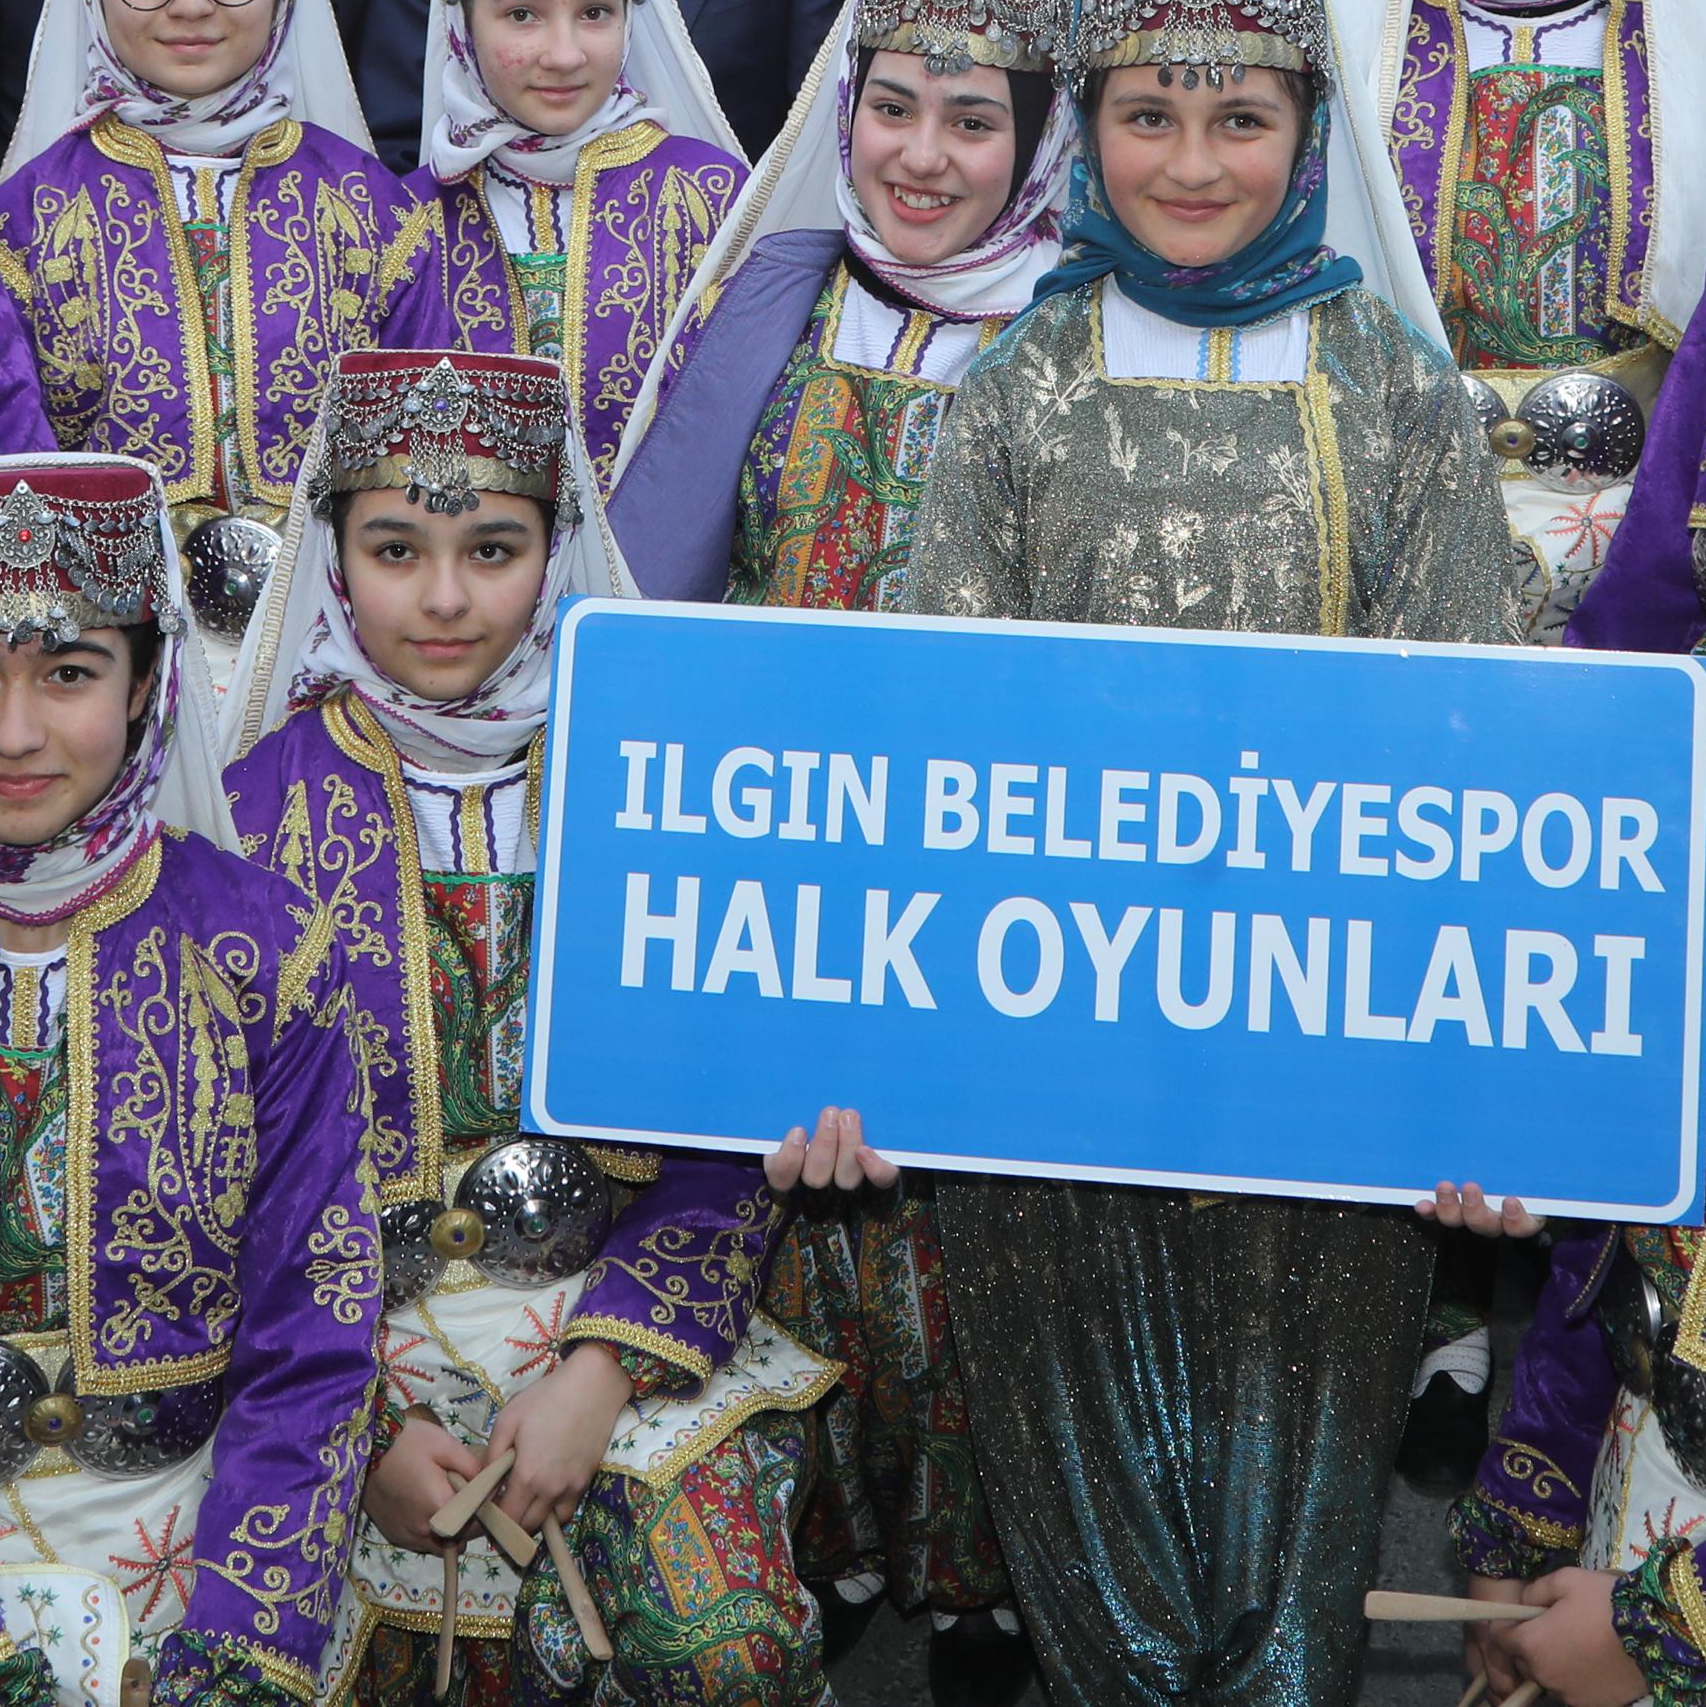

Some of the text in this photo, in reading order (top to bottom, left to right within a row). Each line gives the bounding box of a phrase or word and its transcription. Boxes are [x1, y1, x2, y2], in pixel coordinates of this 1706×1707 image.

[614, 740, 1666, 894] ILGIN BELEDİYESPOR
[620, 872, 1647, 1056] HALK OYUNLARI
